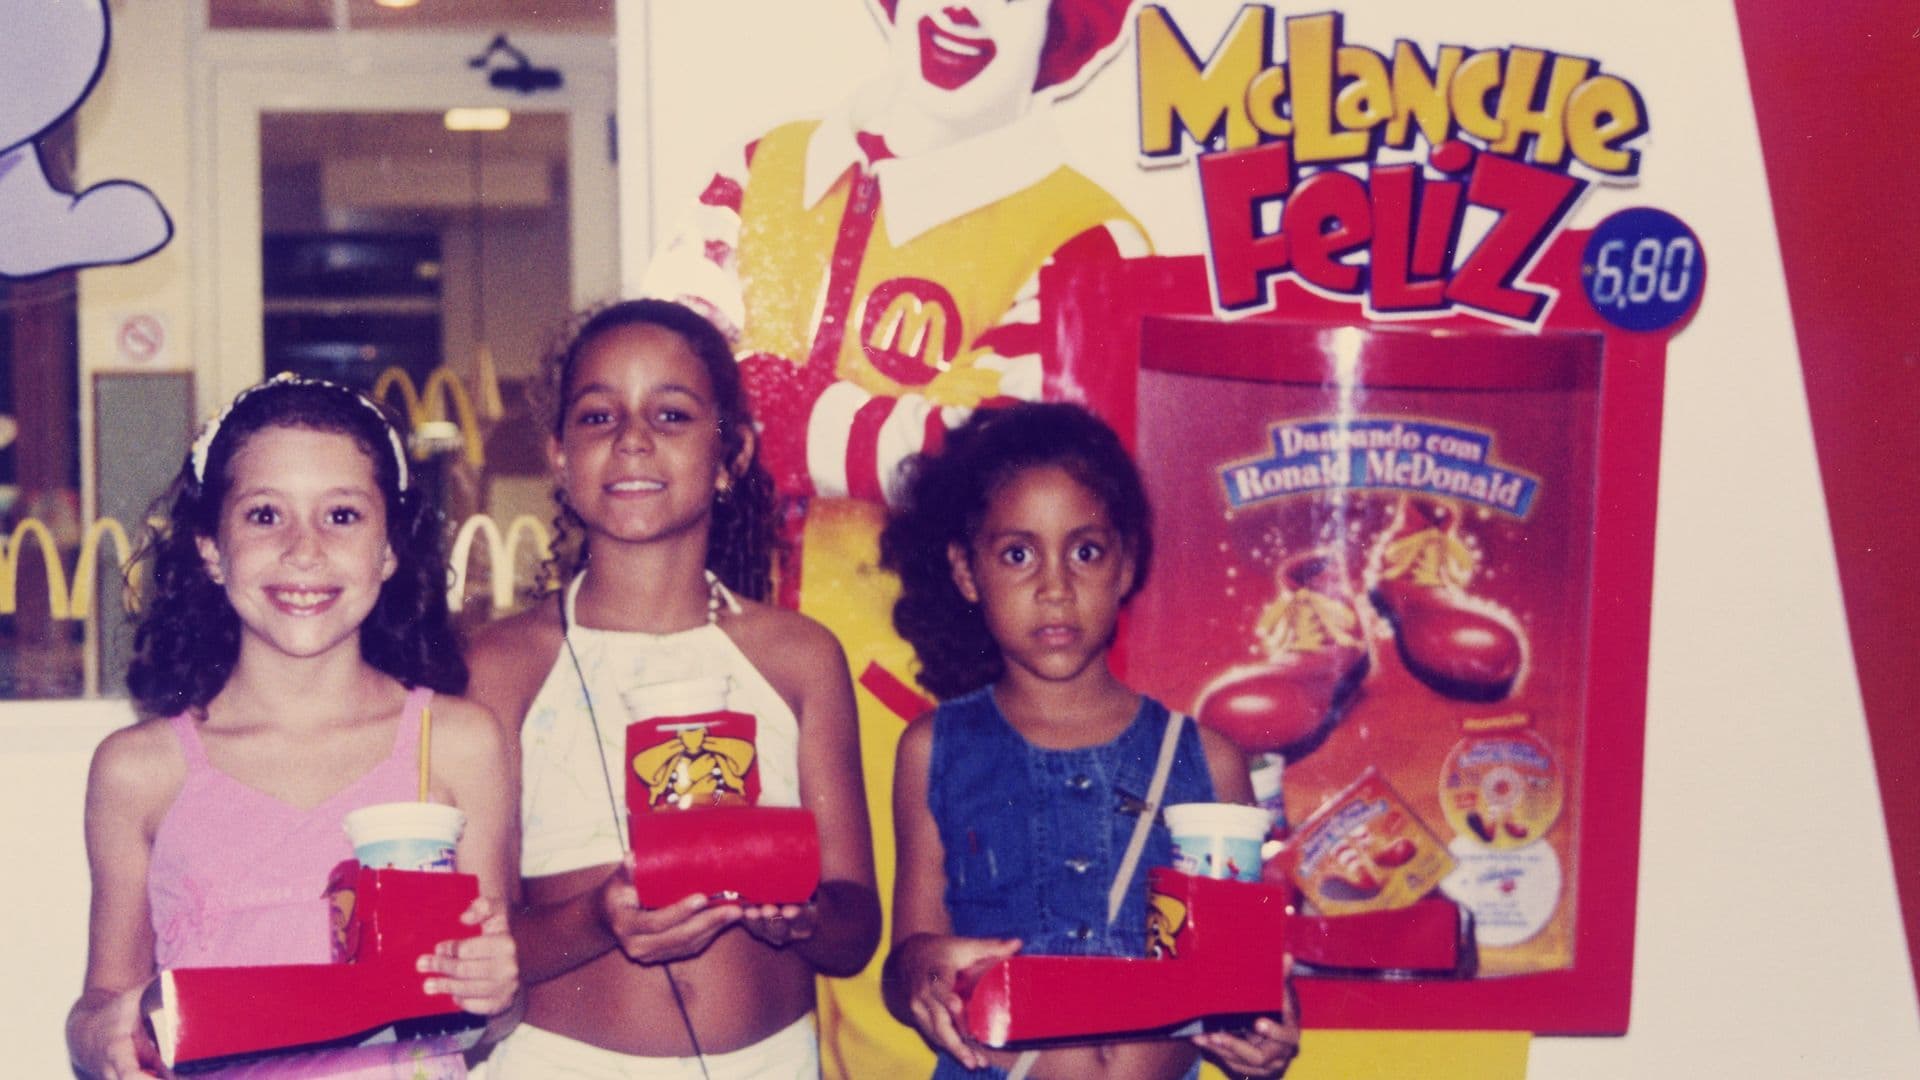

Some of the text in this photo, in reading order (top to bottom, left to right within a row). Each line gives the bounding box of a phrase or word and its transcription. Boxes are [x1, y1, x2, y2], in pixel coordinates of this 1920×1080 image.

[1279, 424, 1482, 461] Danando com
[1234, 450, 1524, 507] Ronald McDonald
